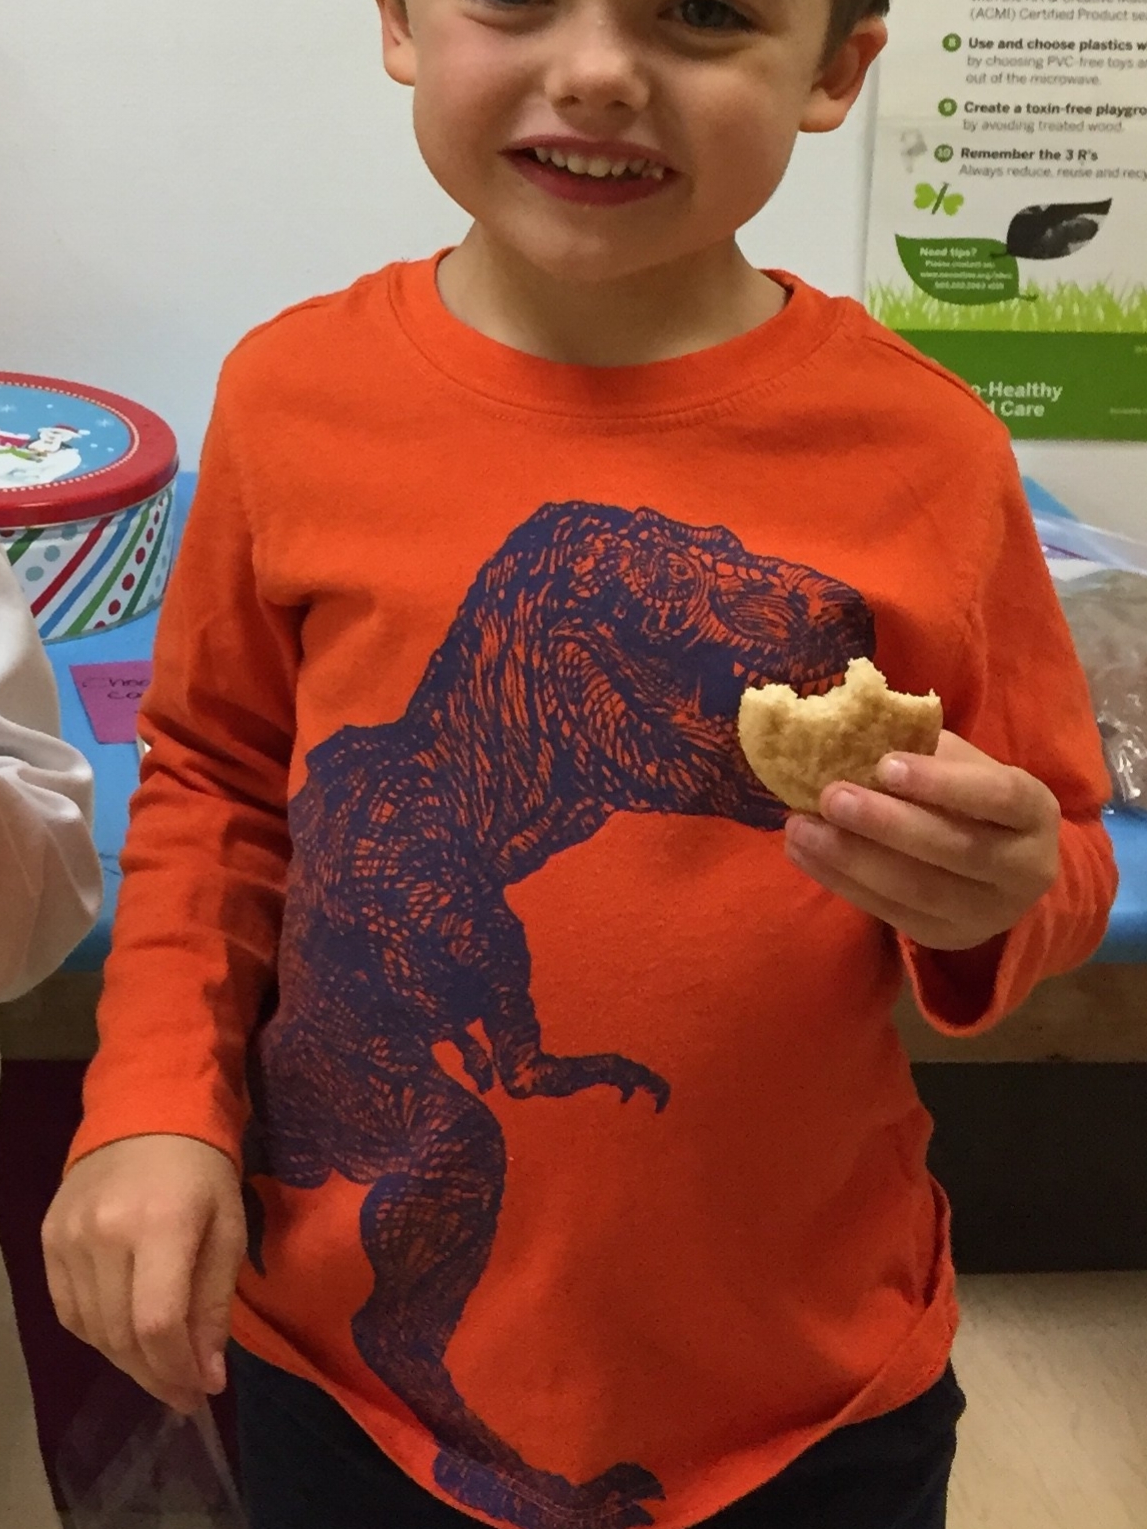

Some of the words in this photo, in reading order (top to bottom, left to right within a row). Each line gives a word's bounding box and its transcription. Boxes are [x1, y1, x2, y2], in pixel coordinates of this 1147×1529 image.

[969, 38, 994, 48] Use
[998, 38, 1023, 49] and
[1027, 39, 1075, 49] choose
[1079, 39, 1132, 52] plastics
[964, 102, 1009, 113] Create
[1014, 105, 1022, 113] a
[1026, 103, 1092, 114] toxin-free
[961, 148, 1035, 159] Remember
[1039, 149, 1061, 159] the
[1065, 150, 1073, 160] 3
[1078, 150, 1098, 160] R's
[920, 248, 947, 256] Need
[971, 381, 1063, 402] o-Healthy
[1000, 401, 1045, 417] Care
